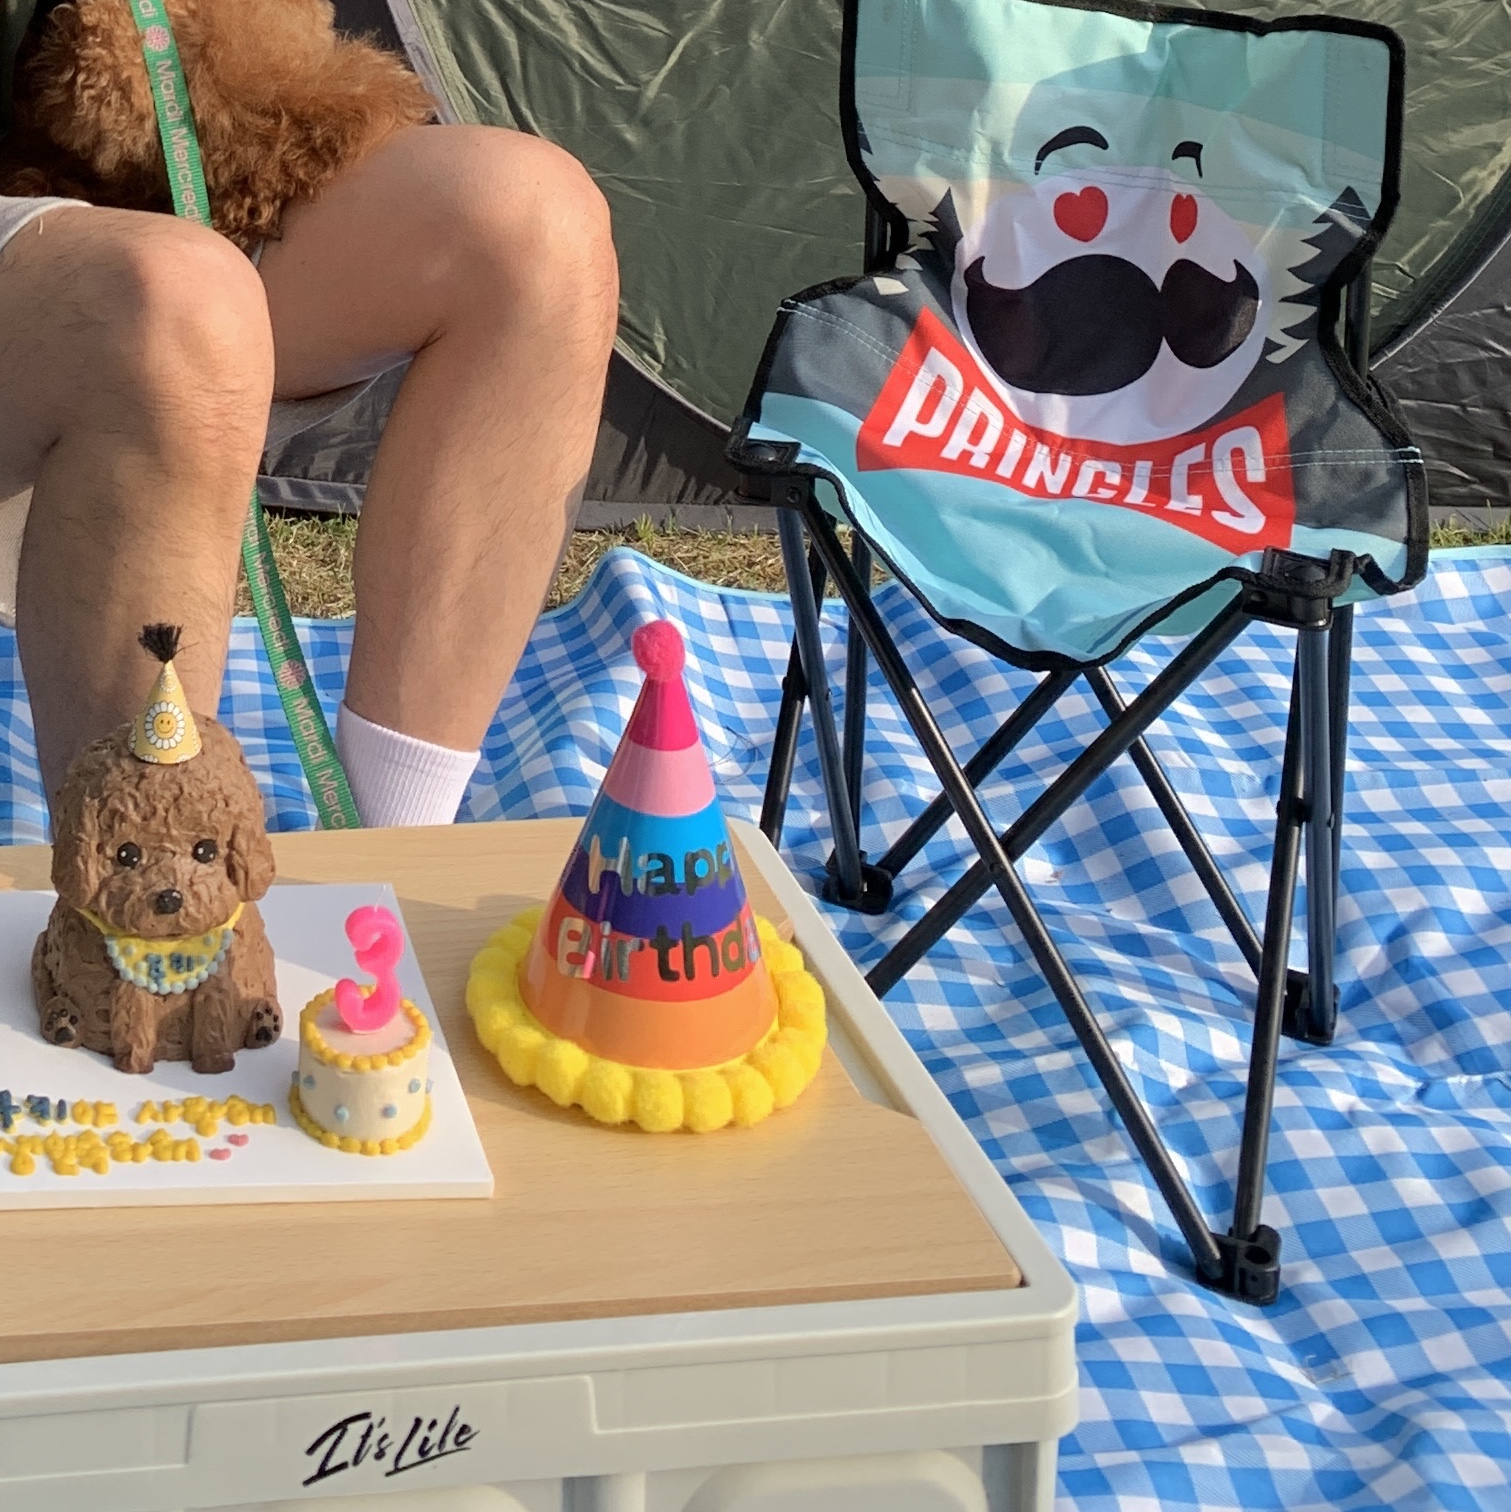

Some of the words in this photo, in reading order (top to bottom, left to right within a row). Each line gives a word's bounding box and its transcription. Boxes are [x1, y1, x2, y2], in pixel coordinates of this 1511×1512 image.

[156, 59, 184, 124] Mardi
[882, 346, 1268, 535] PRINGLES
[292, 696, 327, 767] Mardi
[316, 768, 348, 830] Merc
[588, 834, 733, 897] Happ
[335, 905, 405, 1034] 3
